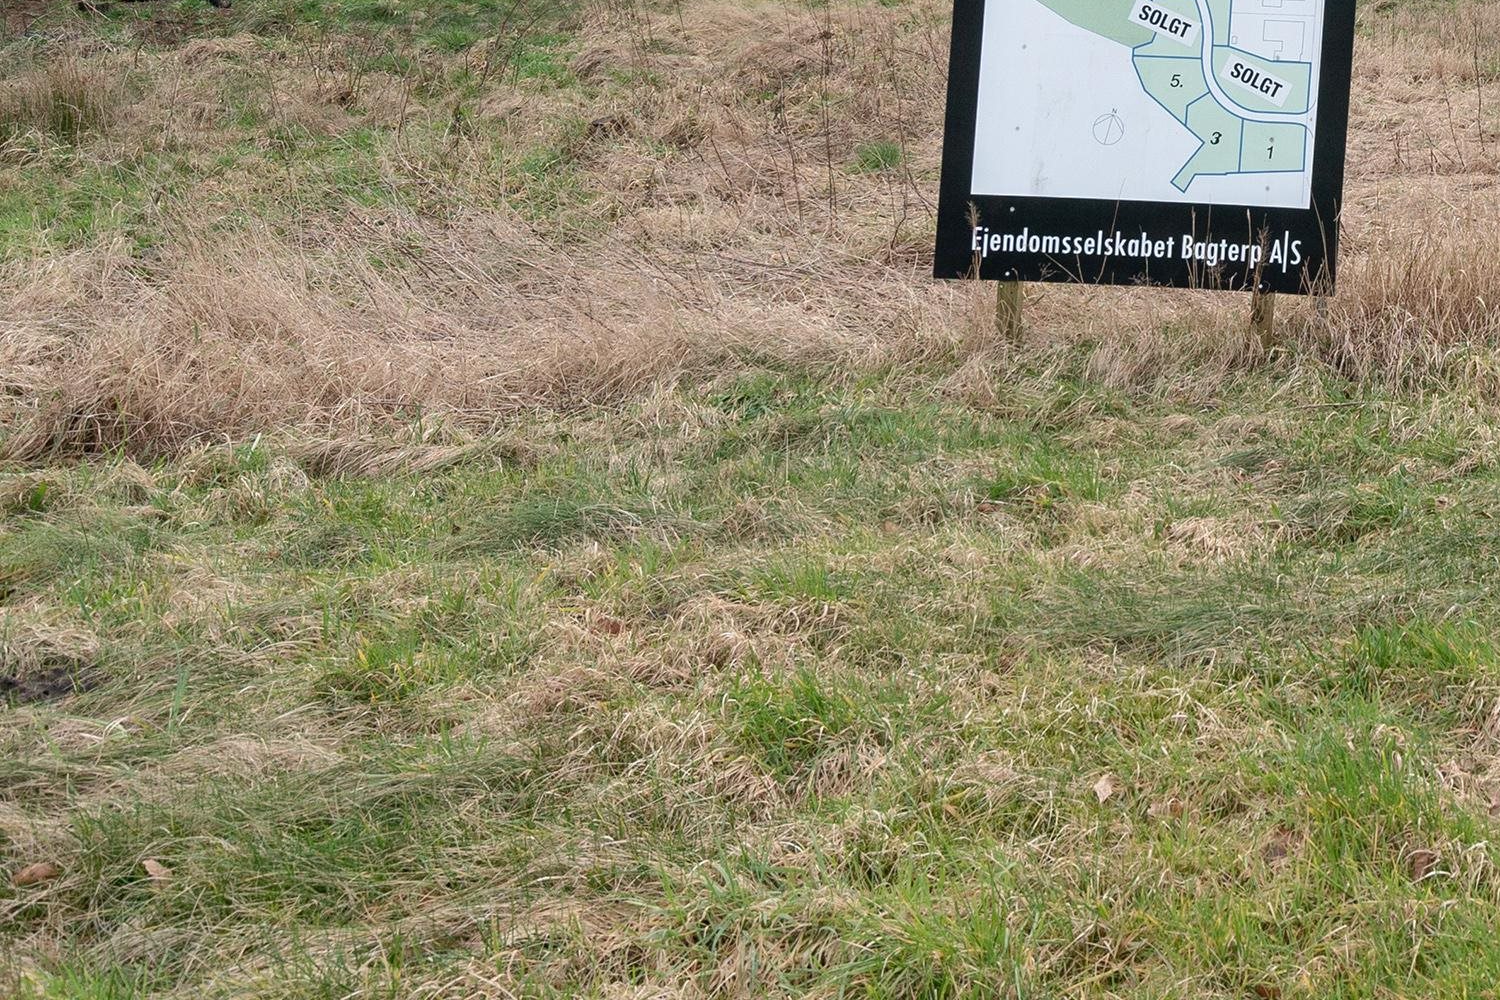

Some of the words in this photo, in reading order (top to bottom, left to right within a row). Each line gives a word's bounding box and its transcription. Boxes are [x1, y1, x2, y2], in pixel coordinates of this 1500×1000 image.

[1138, 5, 1192, 39] SOLGT
[1170, 74, 1184, 88] 5.
[1230, 62, 1284, 99] SOLGT
[1209, 131, 1223, 145] 3
[1266, 146, 1275, 160] 1
[971, 226, 1174, 258] Ejendomsselskabet
[1181, 234, 1262, 269] Bagterp
